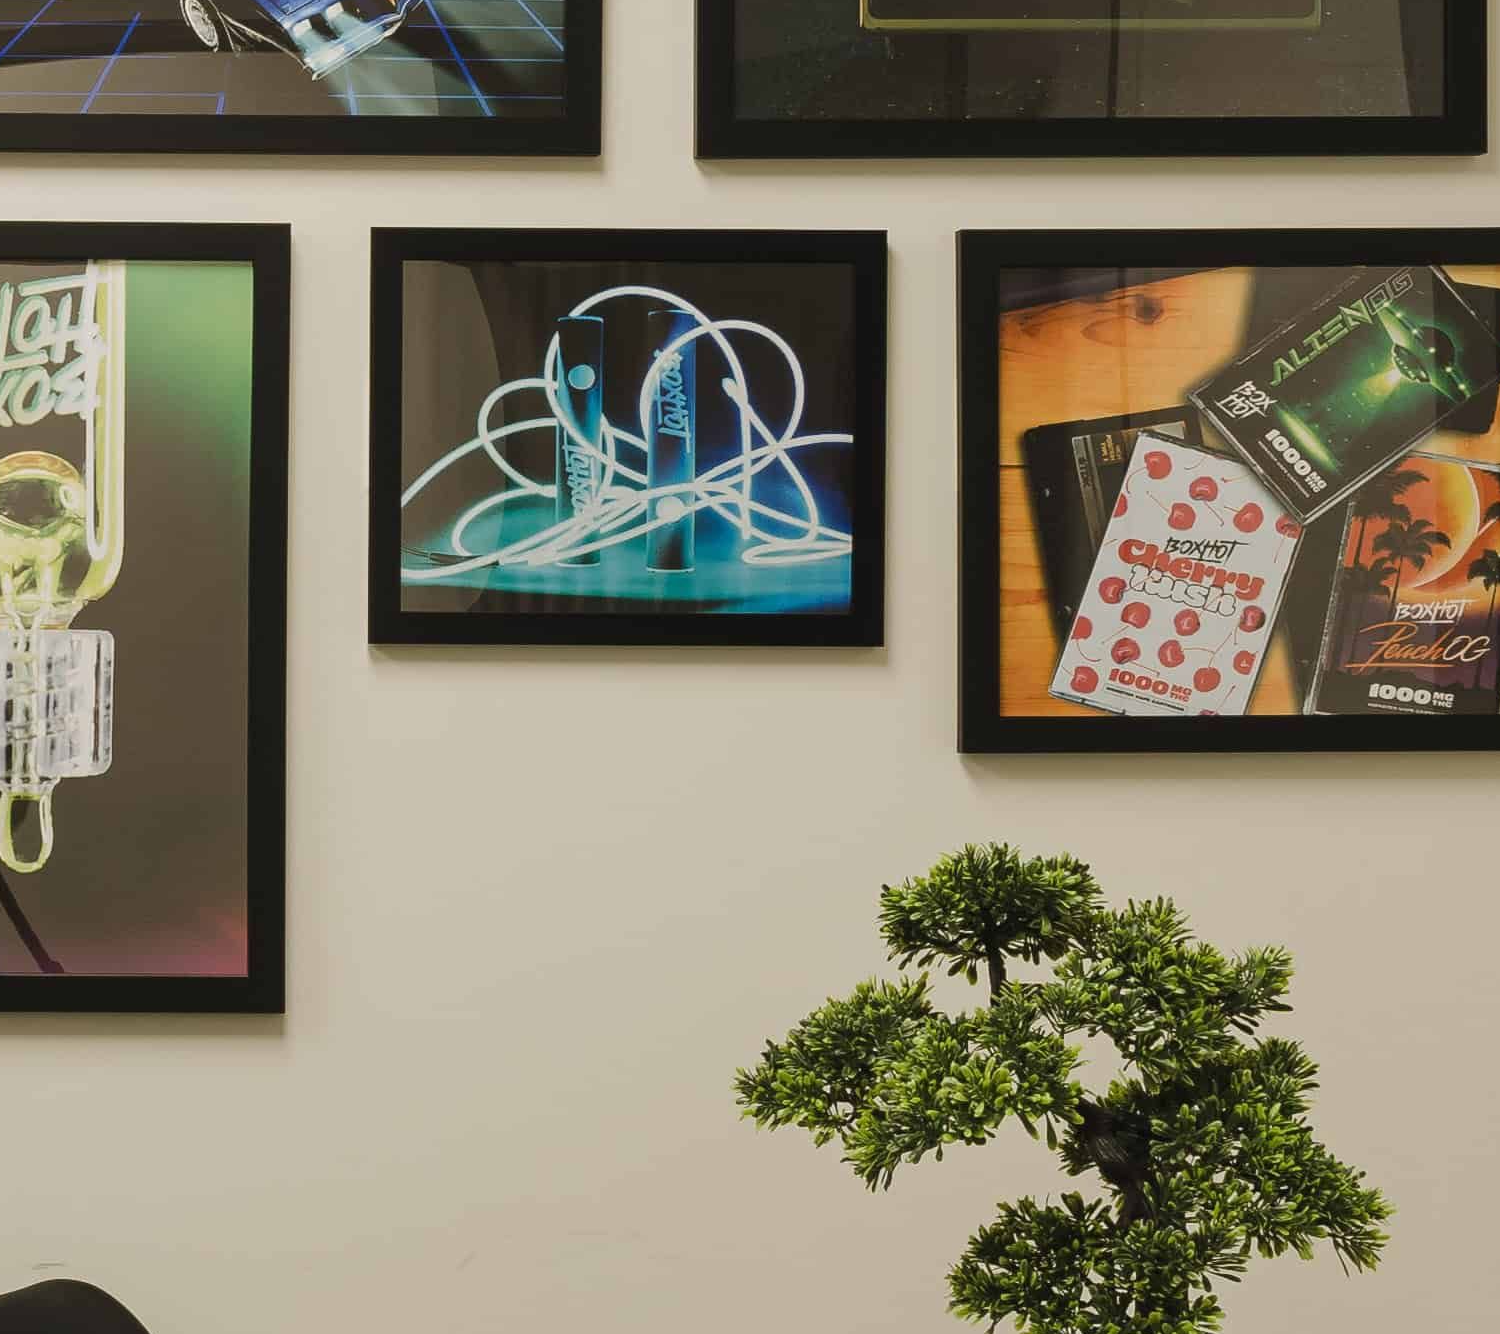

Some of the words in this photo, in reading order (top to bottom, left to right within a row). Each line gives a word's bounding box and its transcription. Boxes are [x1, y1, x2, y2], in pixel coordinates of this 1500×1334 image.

[1215, 393, 1267, 419] HOT
[1232, 380, 1278, 411] BOX
[1265, 428, 1311, 476] 1000
[1165, 537, 1249, 563] BOXHOT
[1118, 538, 1264, 601] Cherry
[1393, 598, 1480, 624] BOXHOT
[1345, 621, 1454, 673] Peach
[1443, 635, 1491, 662] OG
[1109, 668, 1169, 695] 1000
[1368, 683, 1432, 704] 1000
[1432, 691, 1455, 702] MG
[1432, 699, 1454, 709] THC
